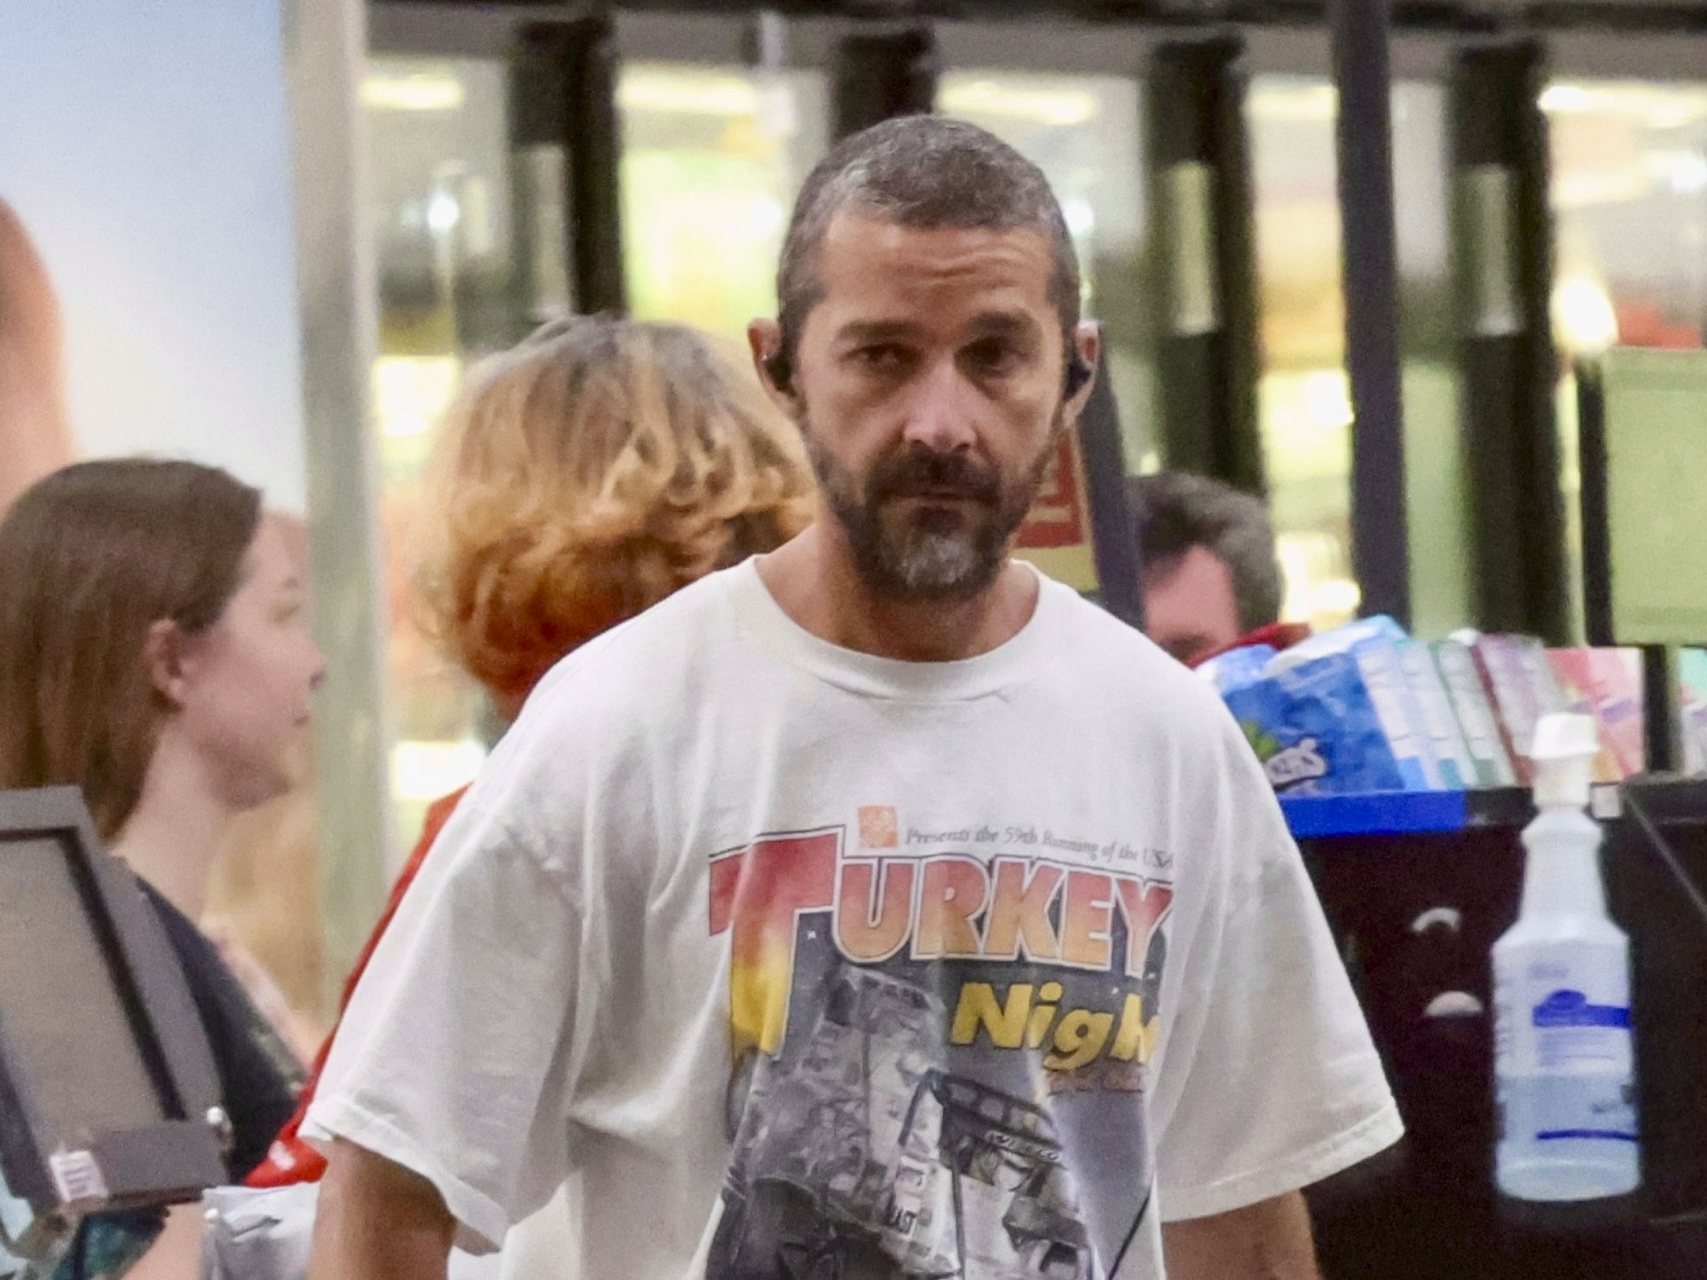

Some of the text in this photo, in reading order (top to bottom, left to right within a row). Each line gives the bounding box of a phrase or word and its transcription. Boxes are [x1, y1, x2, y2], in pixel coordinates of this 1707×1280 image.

[905, 828, 970, 845] Presents
[974, 824, 999, 842] the
[1004, 825, 1038, 845] 59th
[1042, 830, 1099, 861] Running
[1101, 841, 1119, 863] of
[1119, 844, 1138, 861] the
[708, 824, 1174, 1064] TURKEY
